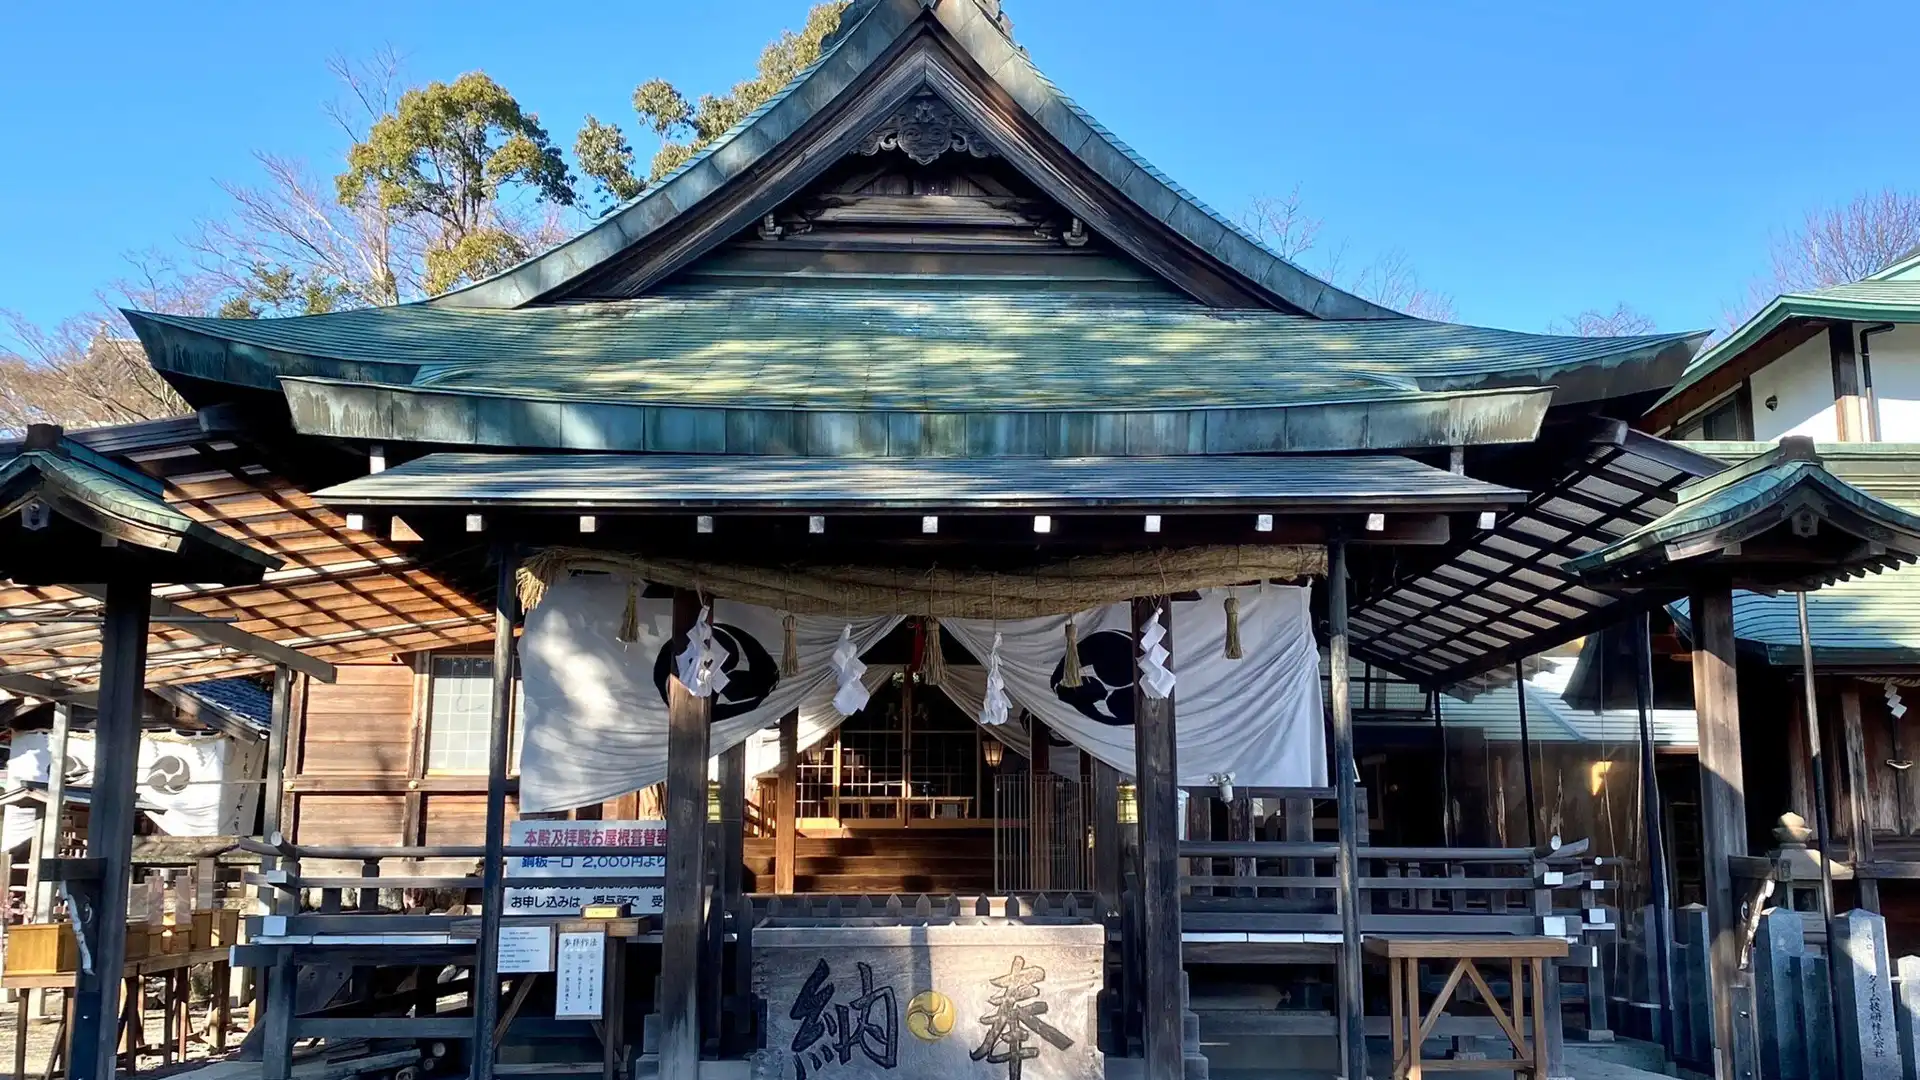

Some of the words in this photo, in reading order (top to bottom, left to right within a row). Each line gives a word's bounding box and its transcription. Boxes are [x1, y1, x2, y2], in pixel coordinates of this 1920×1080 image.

[511, 895, 580, 908] お申し込みは
